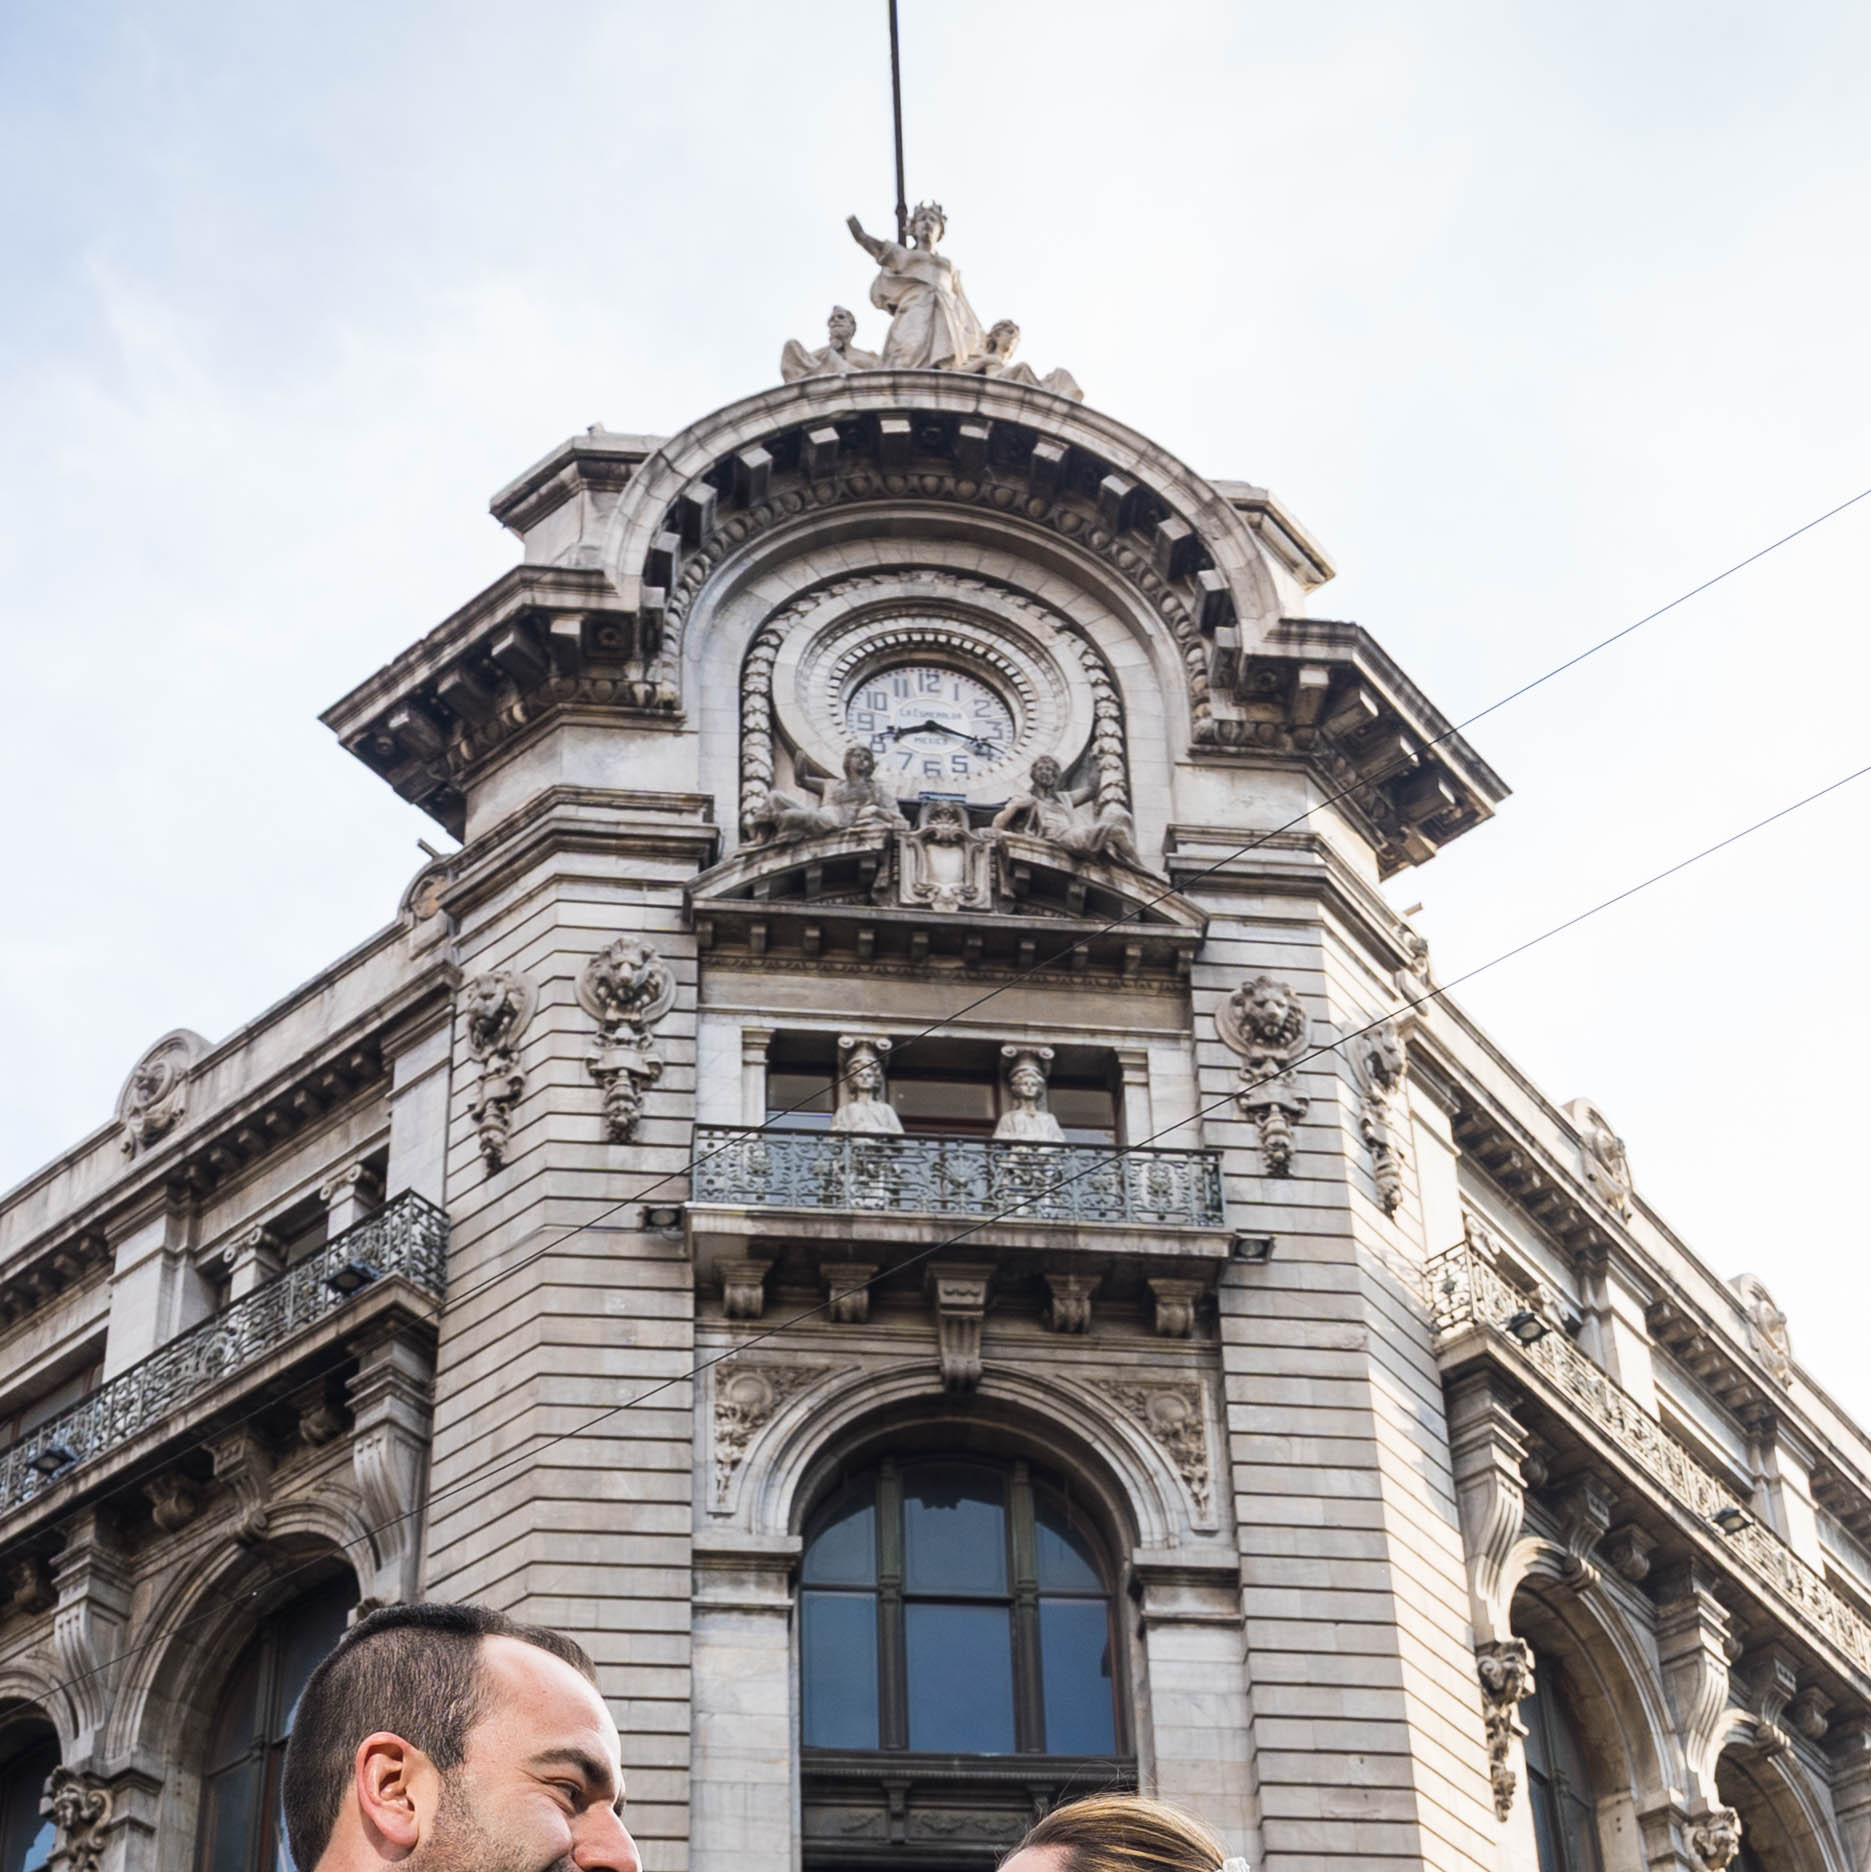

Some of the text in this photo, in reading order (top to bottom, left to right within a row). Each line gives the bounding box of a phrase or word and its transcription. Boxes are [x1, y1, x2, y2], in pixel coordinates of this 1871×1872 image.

[894, 678, 908, 698] 11
[918, 673, 940, 693] 12
[954, 683, 959, 701] 1
[866, 691, 888, 711] 10
[974, 699, 991, 718] 2
[857, 712, 874, 732] 9
[985, 720, 1003, 740] 3
[870, 735, 886, 754] 8
[896, 751, 913, 770] 7
[923, 760, 941, 776] 6
[952, 755, 968, 773] 5
